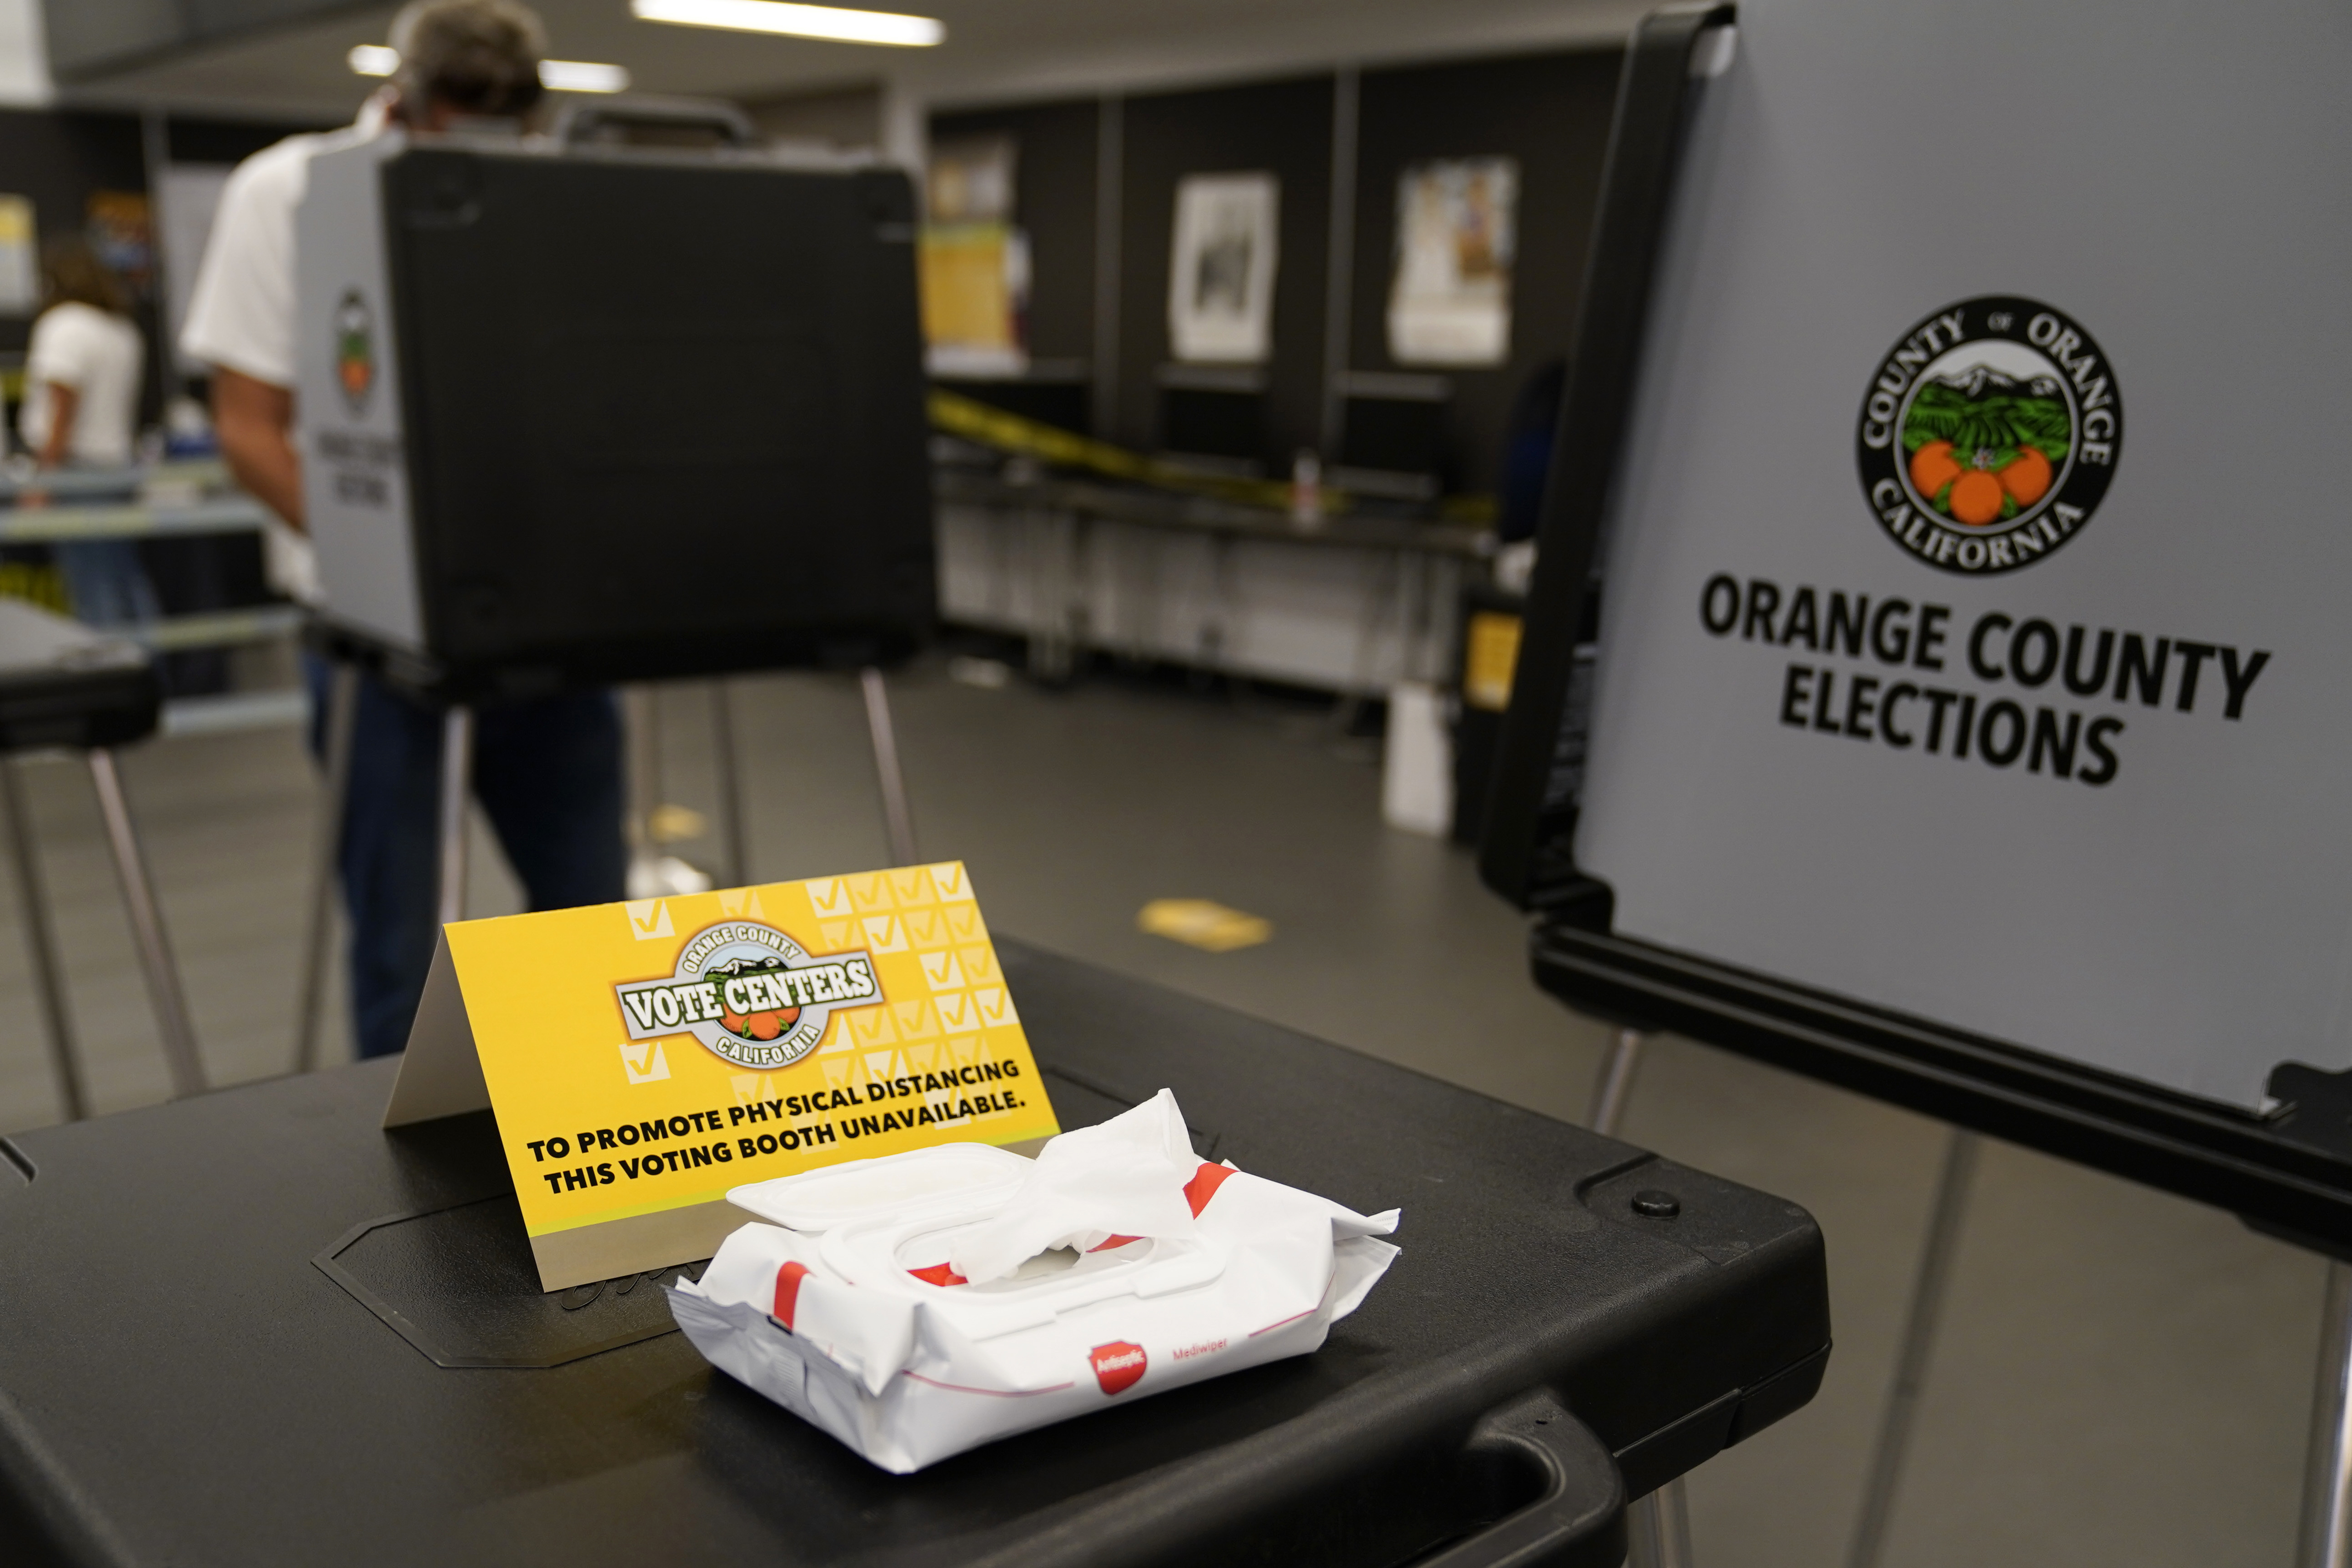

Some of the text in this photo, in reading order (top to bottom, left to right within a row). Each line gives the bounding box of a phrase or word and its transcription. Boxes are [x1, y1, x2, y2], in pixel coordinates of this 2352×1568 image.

[1863, 308, 1966, 449] COUNTY
[2026, 312, 2114, 466] ORANGE
[1871, 477, 2084, 570] CALIFORNIA
[1700, 572, 2272, 720] ORANGE COUNTY
[1780, 663, 2125, 787] ELECTIONS
[624, 959, 875, 1029] VOTE CENTERS
[682, 925, 802, 974] ORANGE COUNTY
[716, 1024, 820, 1065] CALIFORNIA
[527, 1059, 1019, 1162] TO PROMOTE PHYSICAL DISTANCING
[543, 1091, 1026, 1194] THIS VOTING BOOTH UNAVAILABLE.
[1172, 1338, 1228, 1360] Mediwiper
